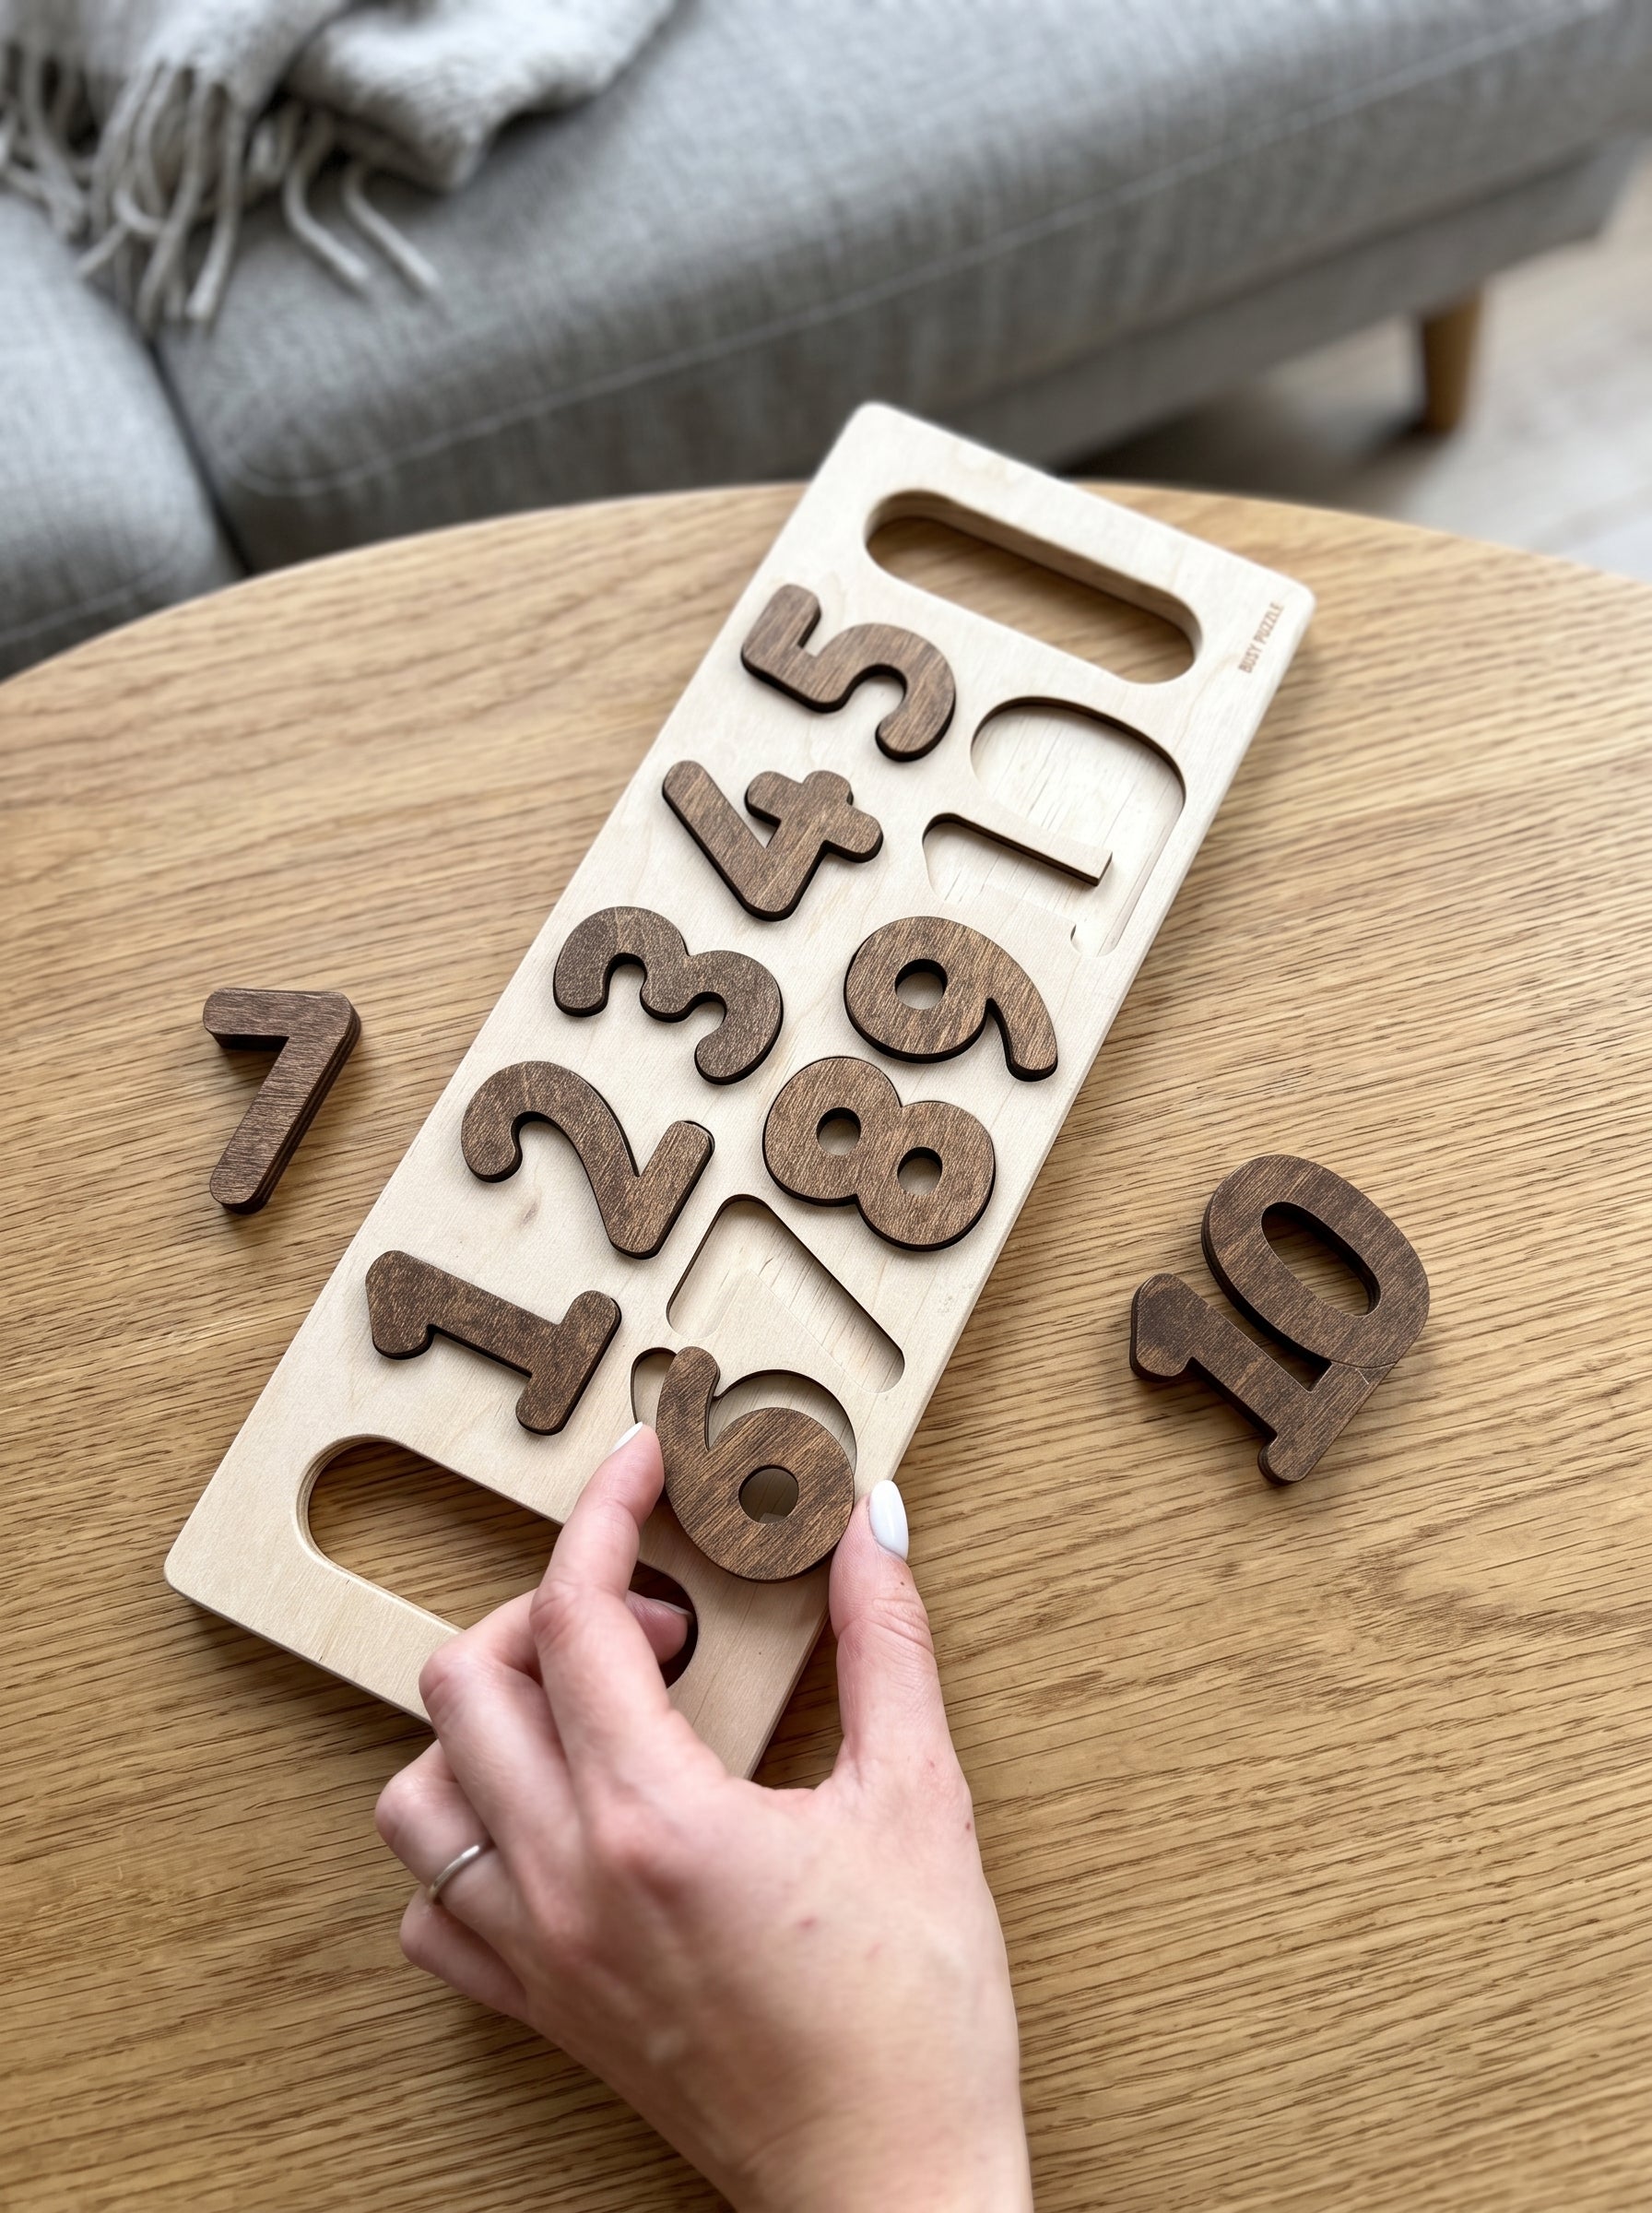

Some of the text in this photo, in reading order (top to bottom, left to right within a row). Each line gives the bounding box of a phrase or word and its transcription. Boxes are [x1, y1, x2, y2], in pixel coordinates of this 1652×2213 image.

[1238, 601, 1284, 673] BUSY PUZZLE
[202, 987, 362, 1215] 7
[366, 584, 956, 1436] 1 2 3 4 5
[844, 915, 1058, 1083] 9
[762, 1056, 996, 1252] 8
[1128, 1154, 1431, 1486] 10
[655, 1346, 856, 1583] 6
